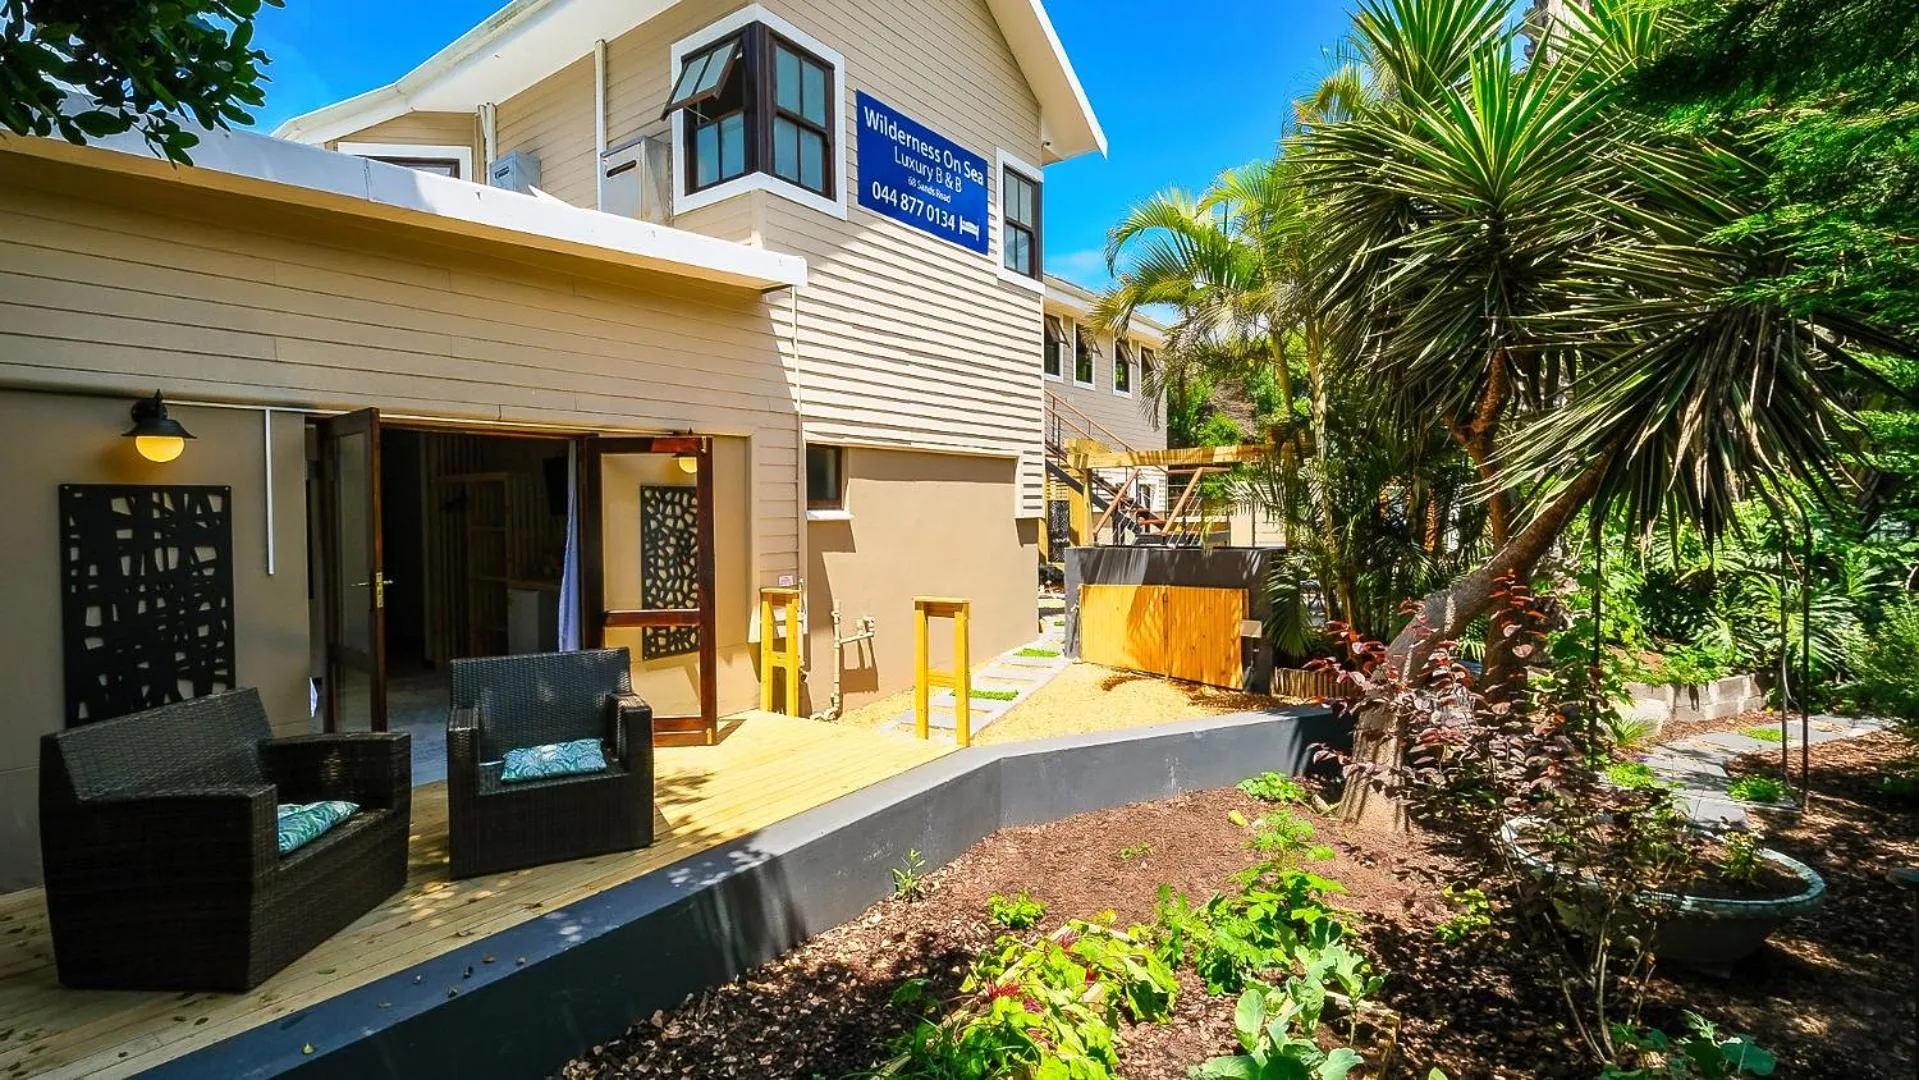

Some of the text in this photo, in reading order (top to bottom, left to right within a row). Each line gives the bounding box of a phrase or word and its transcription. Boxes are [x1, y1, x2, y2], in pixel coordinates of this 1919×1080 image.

[864, 106, 984, 185] Wilderness On Sea
[894, 145, 962, 193] Luxury B & B
[872, 181, 955, 231] 044 877 0134
[917, 179, 935, 197] Sands
[935, 189, 951, 203] Road
